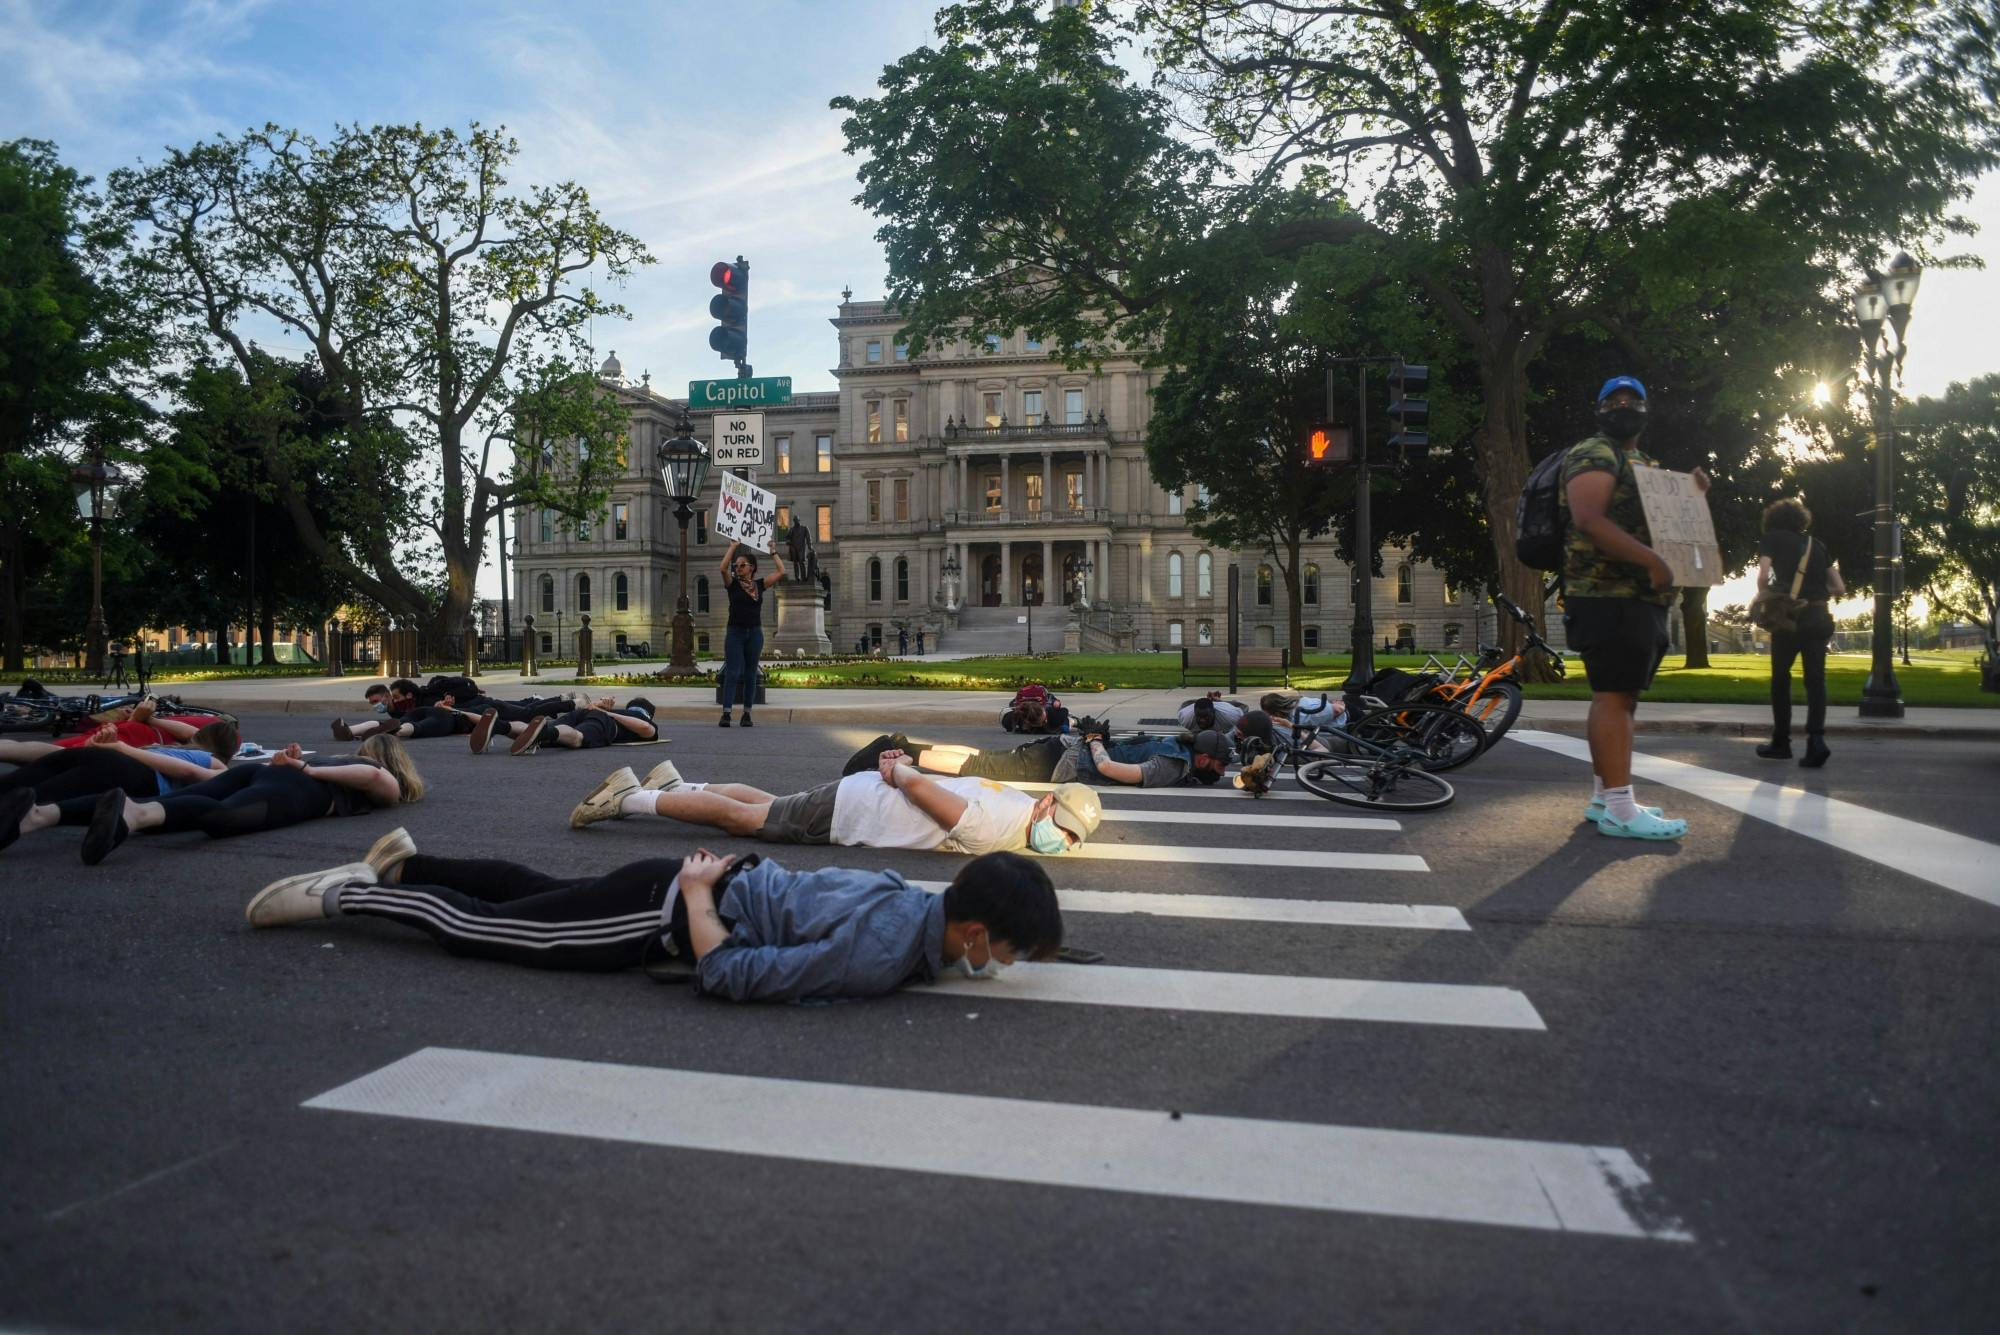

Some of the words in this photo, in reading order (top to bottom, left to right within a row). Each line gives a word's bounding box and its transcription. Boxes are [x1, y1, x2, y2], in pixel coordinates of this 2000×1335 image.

[706, 381, 765, 404] Capitol
[730, 421, 746, 431] NO
[723, 434, 754, 445] TURN
[717, 449, 732, 459] ON
[737, 448, 760, 458] RED
